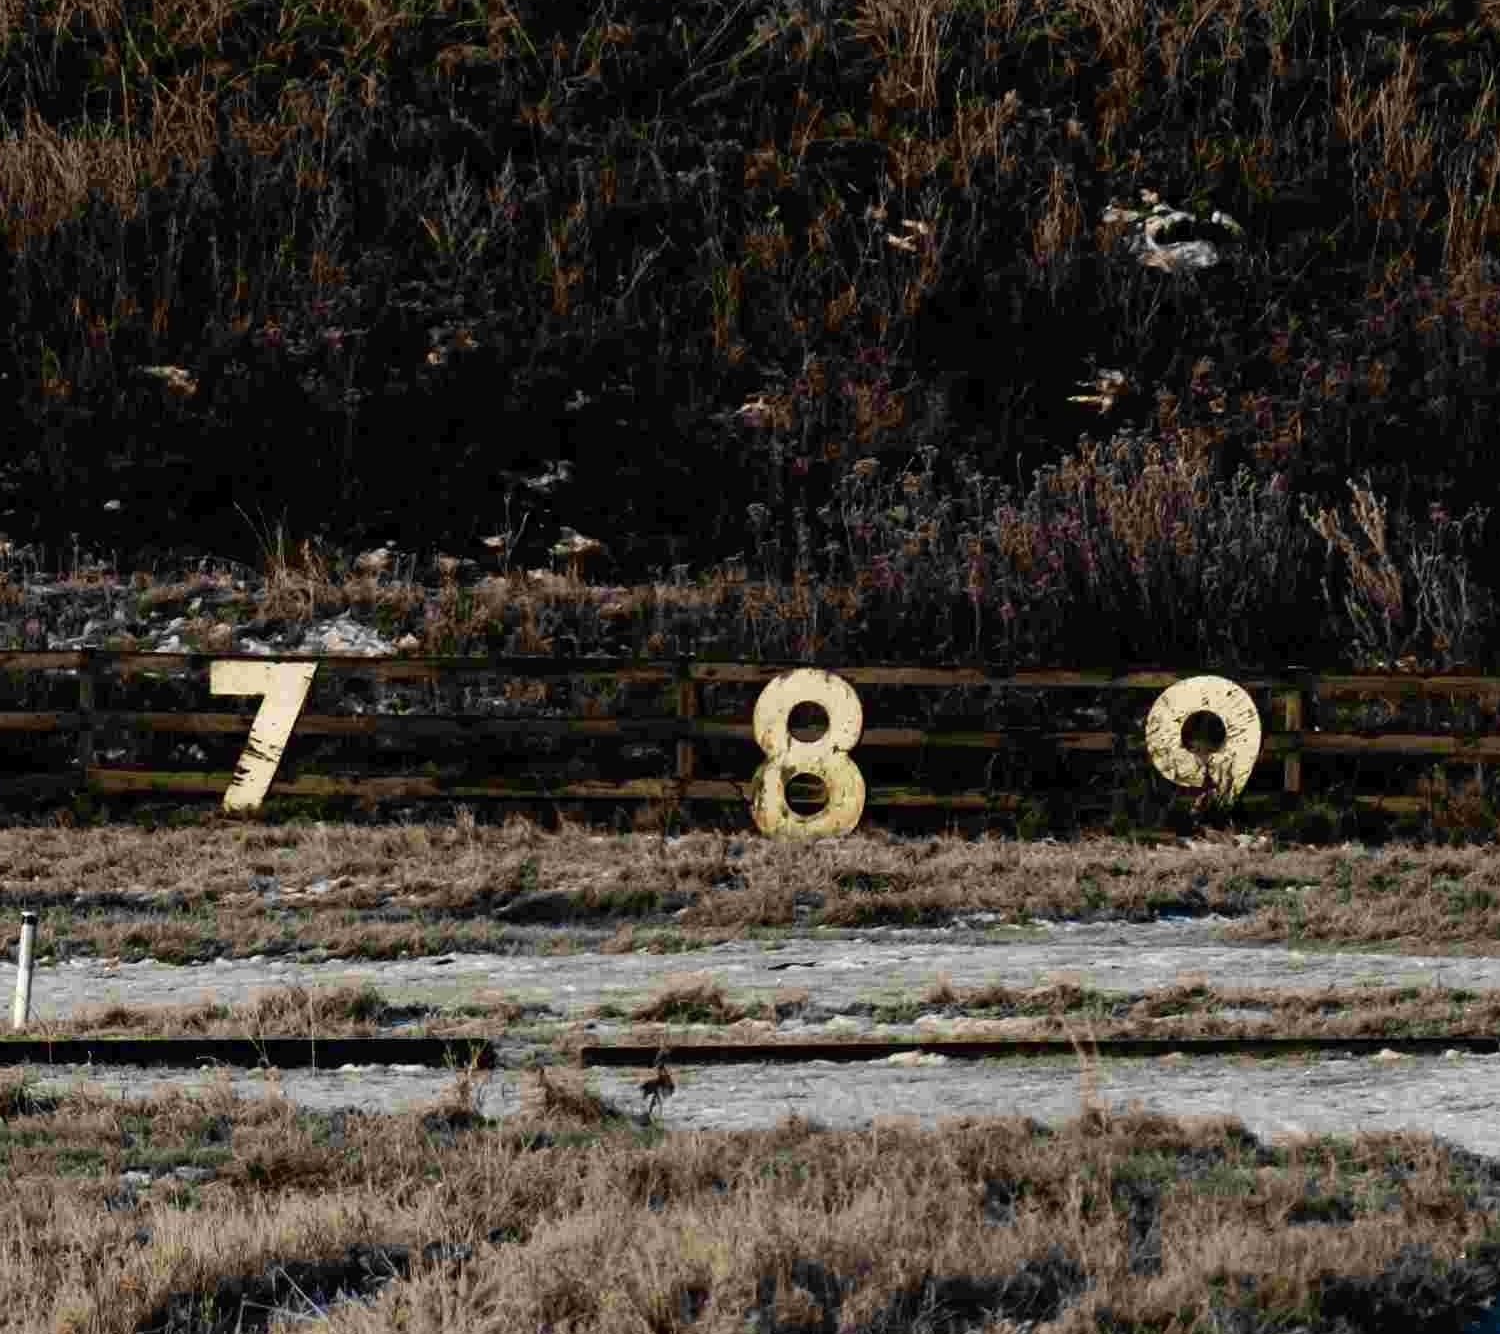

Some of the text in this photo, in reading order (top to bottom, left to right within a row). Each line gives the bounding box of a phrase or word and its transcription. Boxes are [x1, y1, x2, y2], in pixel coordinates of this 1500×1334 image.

[210, 661, 318, 812] 7
[752, 667, 866, 837] 8
[1146, 675, 1263, 810] 9
